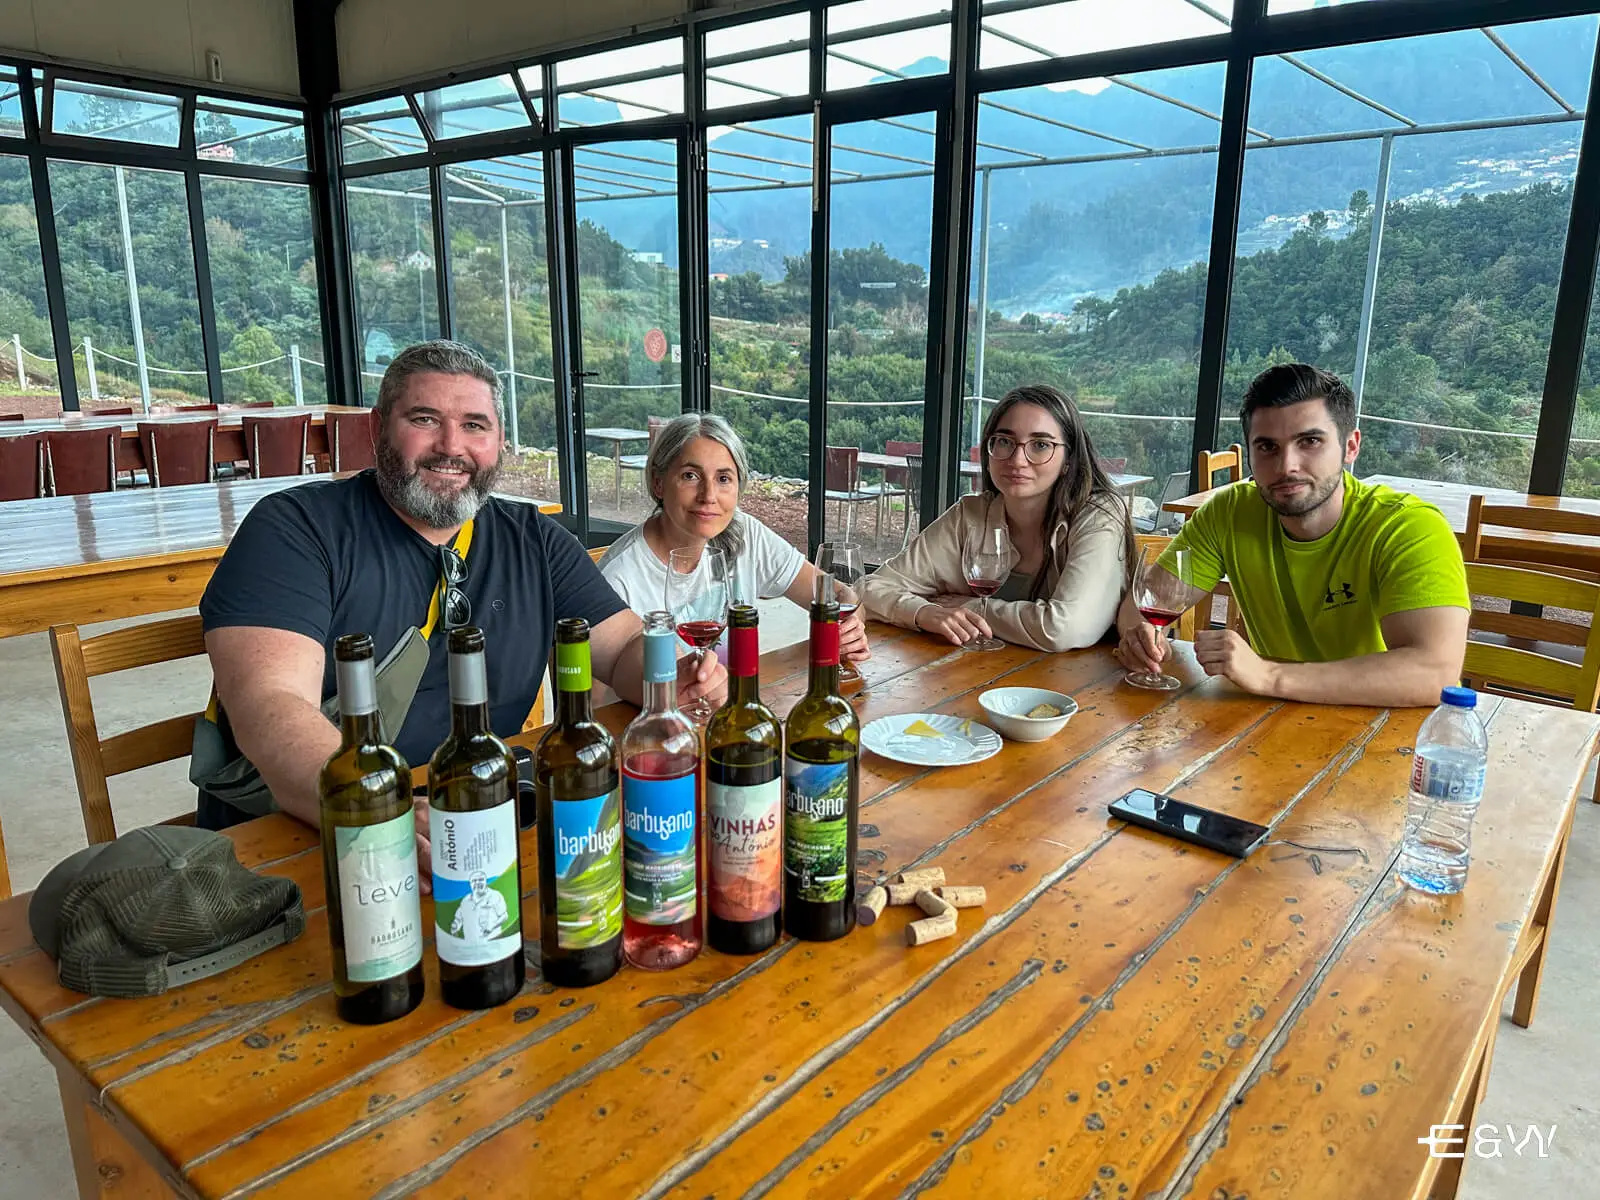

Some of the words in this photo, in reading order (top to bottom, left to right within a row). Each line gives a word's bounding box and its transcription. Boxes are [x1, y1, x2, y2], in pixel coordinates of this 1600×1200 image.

[624, 799, 693, 841] barbusano
[711, 813, 776, 835] VINHAS
[558, 823, 621, 856] barbusan
[352, 874, 415, 906] leve
